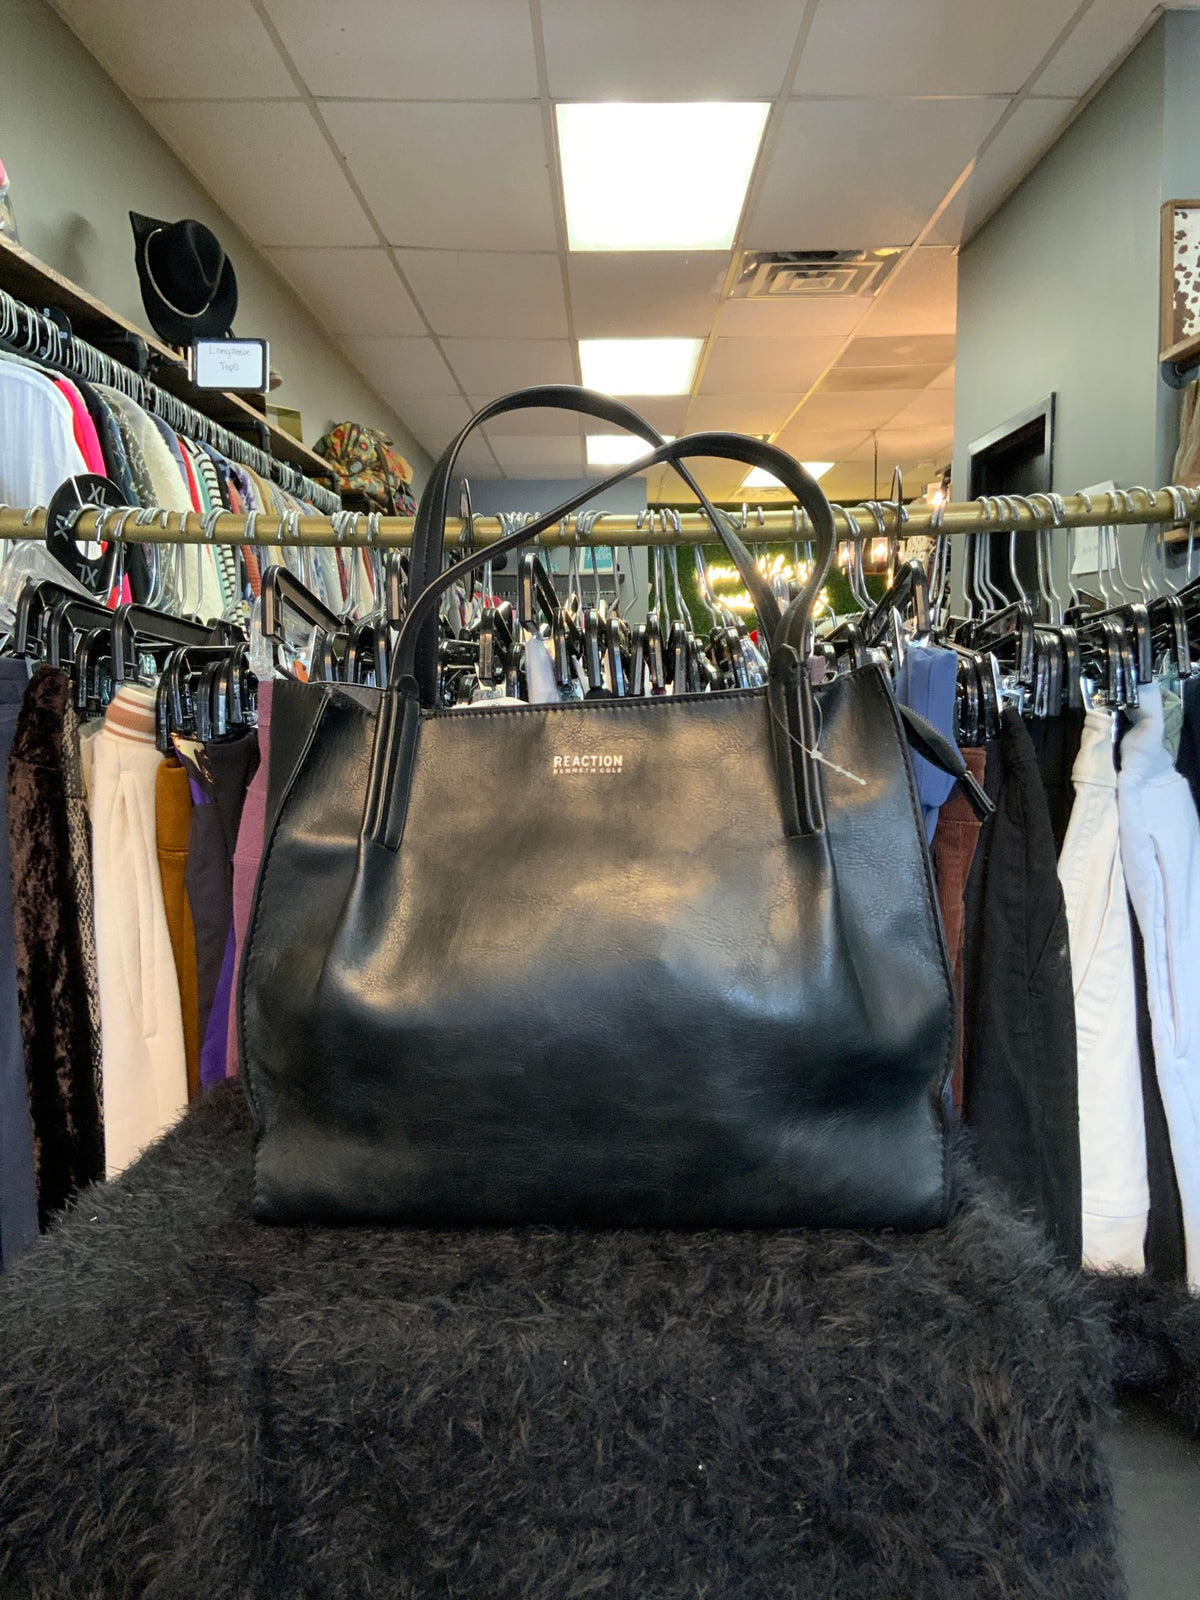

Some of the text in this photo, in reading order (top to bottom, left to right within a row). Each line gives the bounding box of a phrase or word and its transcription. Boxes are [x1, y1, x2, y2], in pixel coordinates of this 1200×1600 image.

[43, 308, 50, 317] S
[87, 483, 107, 506] XL
[76, 562, 98, 588] XL
[553, 755, 623, 767] REACTION
